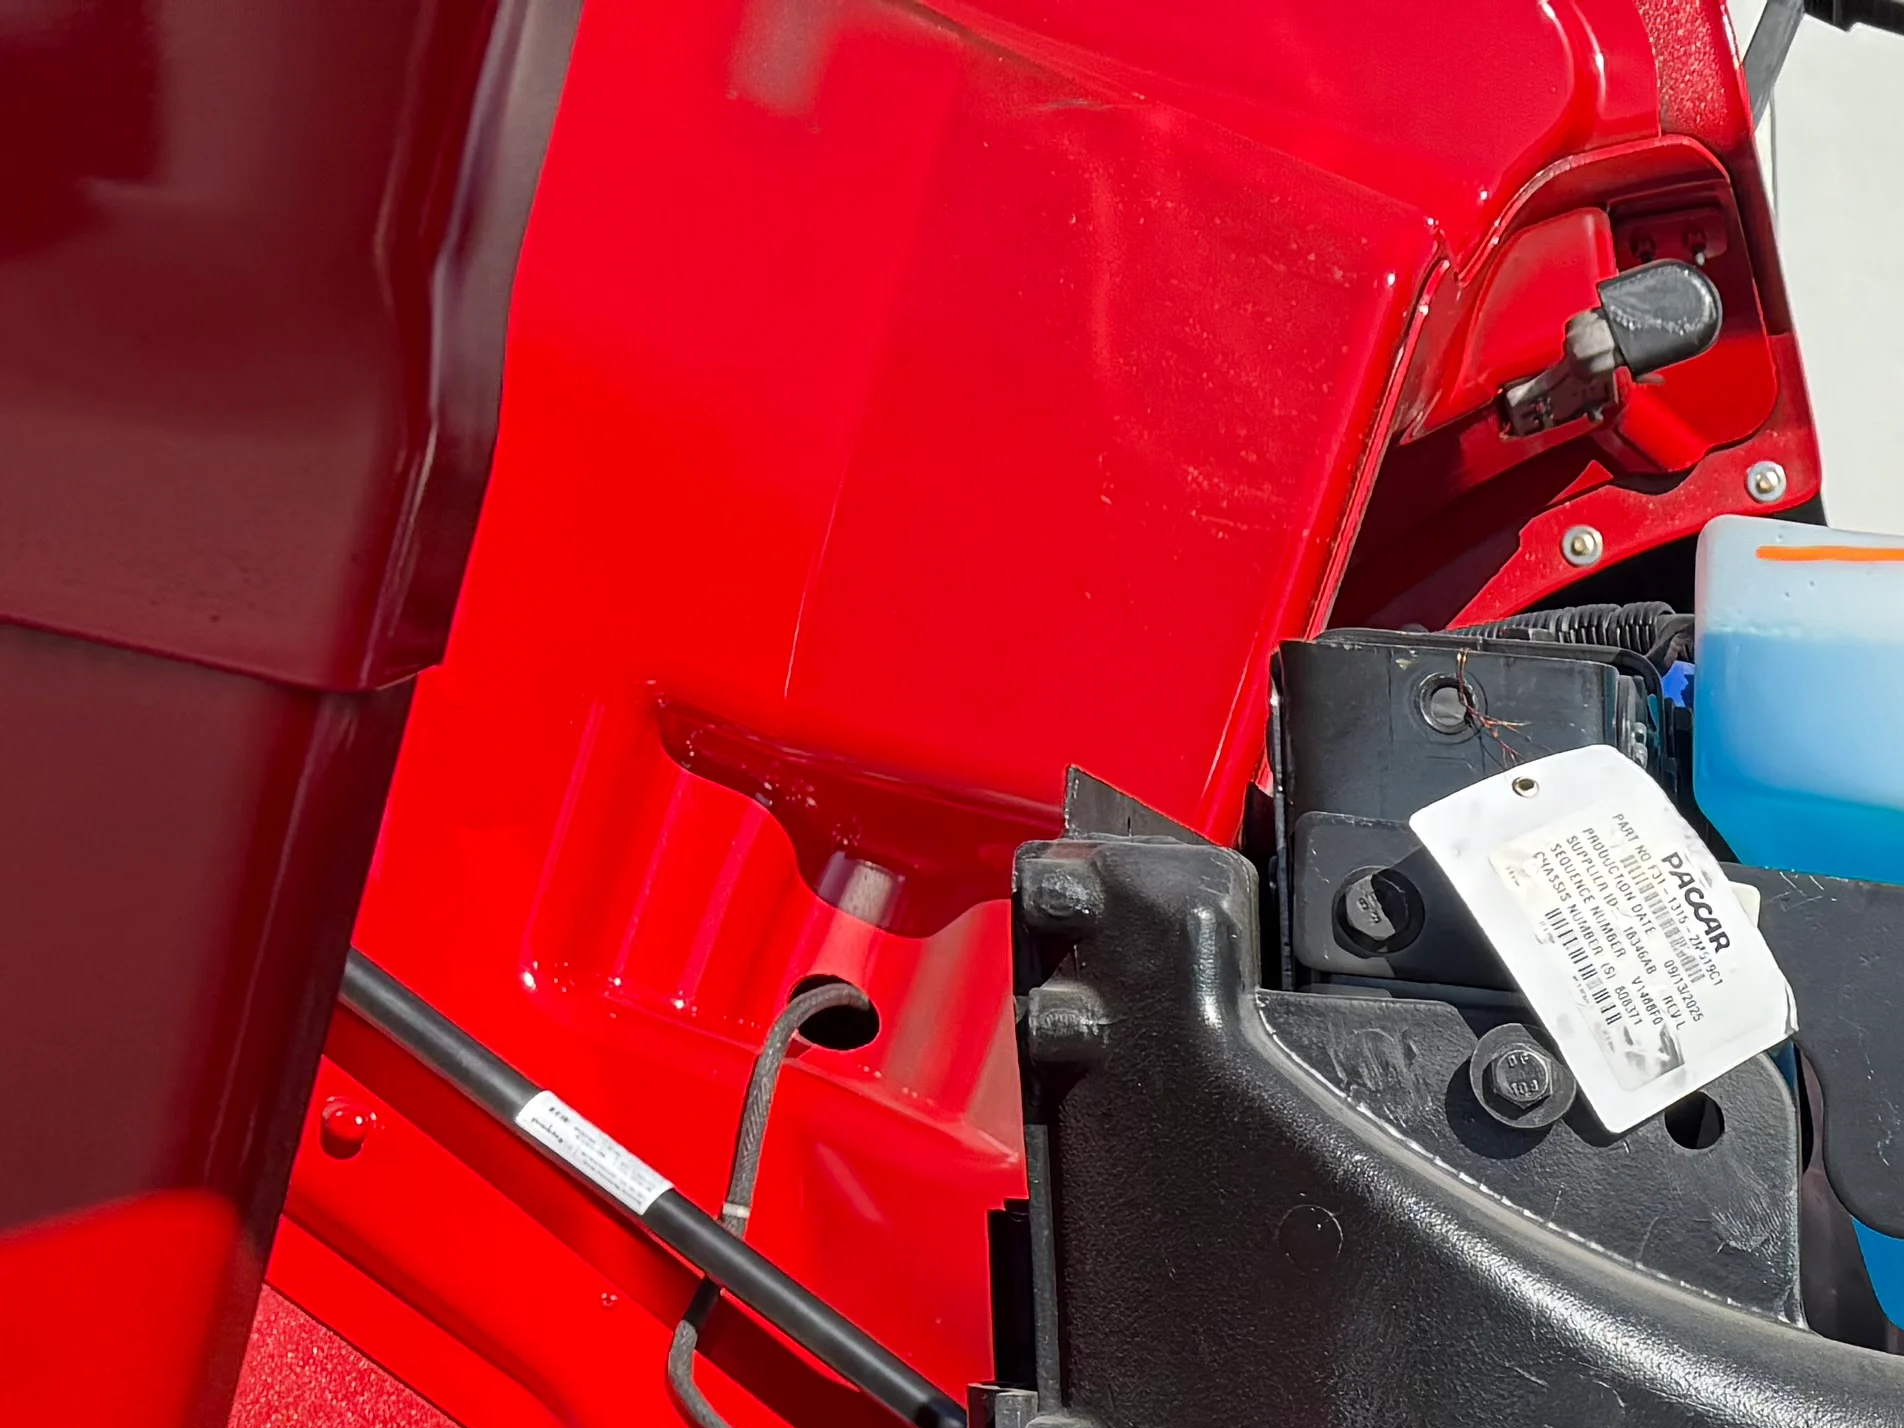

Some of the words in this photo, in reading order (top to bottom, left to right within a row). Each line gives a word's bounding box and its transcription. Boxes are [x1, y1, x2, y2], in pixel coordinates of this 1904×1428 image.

[1565, 833, 1608, 893] SUPPLIER
[1612, 810, 1639, 844] PART
[1532, 849, 1571, 903] CHASSIS
[1565, 902, 1604, 956] NUMBER
[1549, 842, 1594, 905] SEQUENCE
[1588, 904, 1627, 959] NUMBER
[1582, 825, 1636, 903] PRODUCTION
[1630, 902, 1656, 936] DATE
[1660, 958, 1707, 1023] 09/13/2025
[1659, 850, 1733, 954] PACCAR
